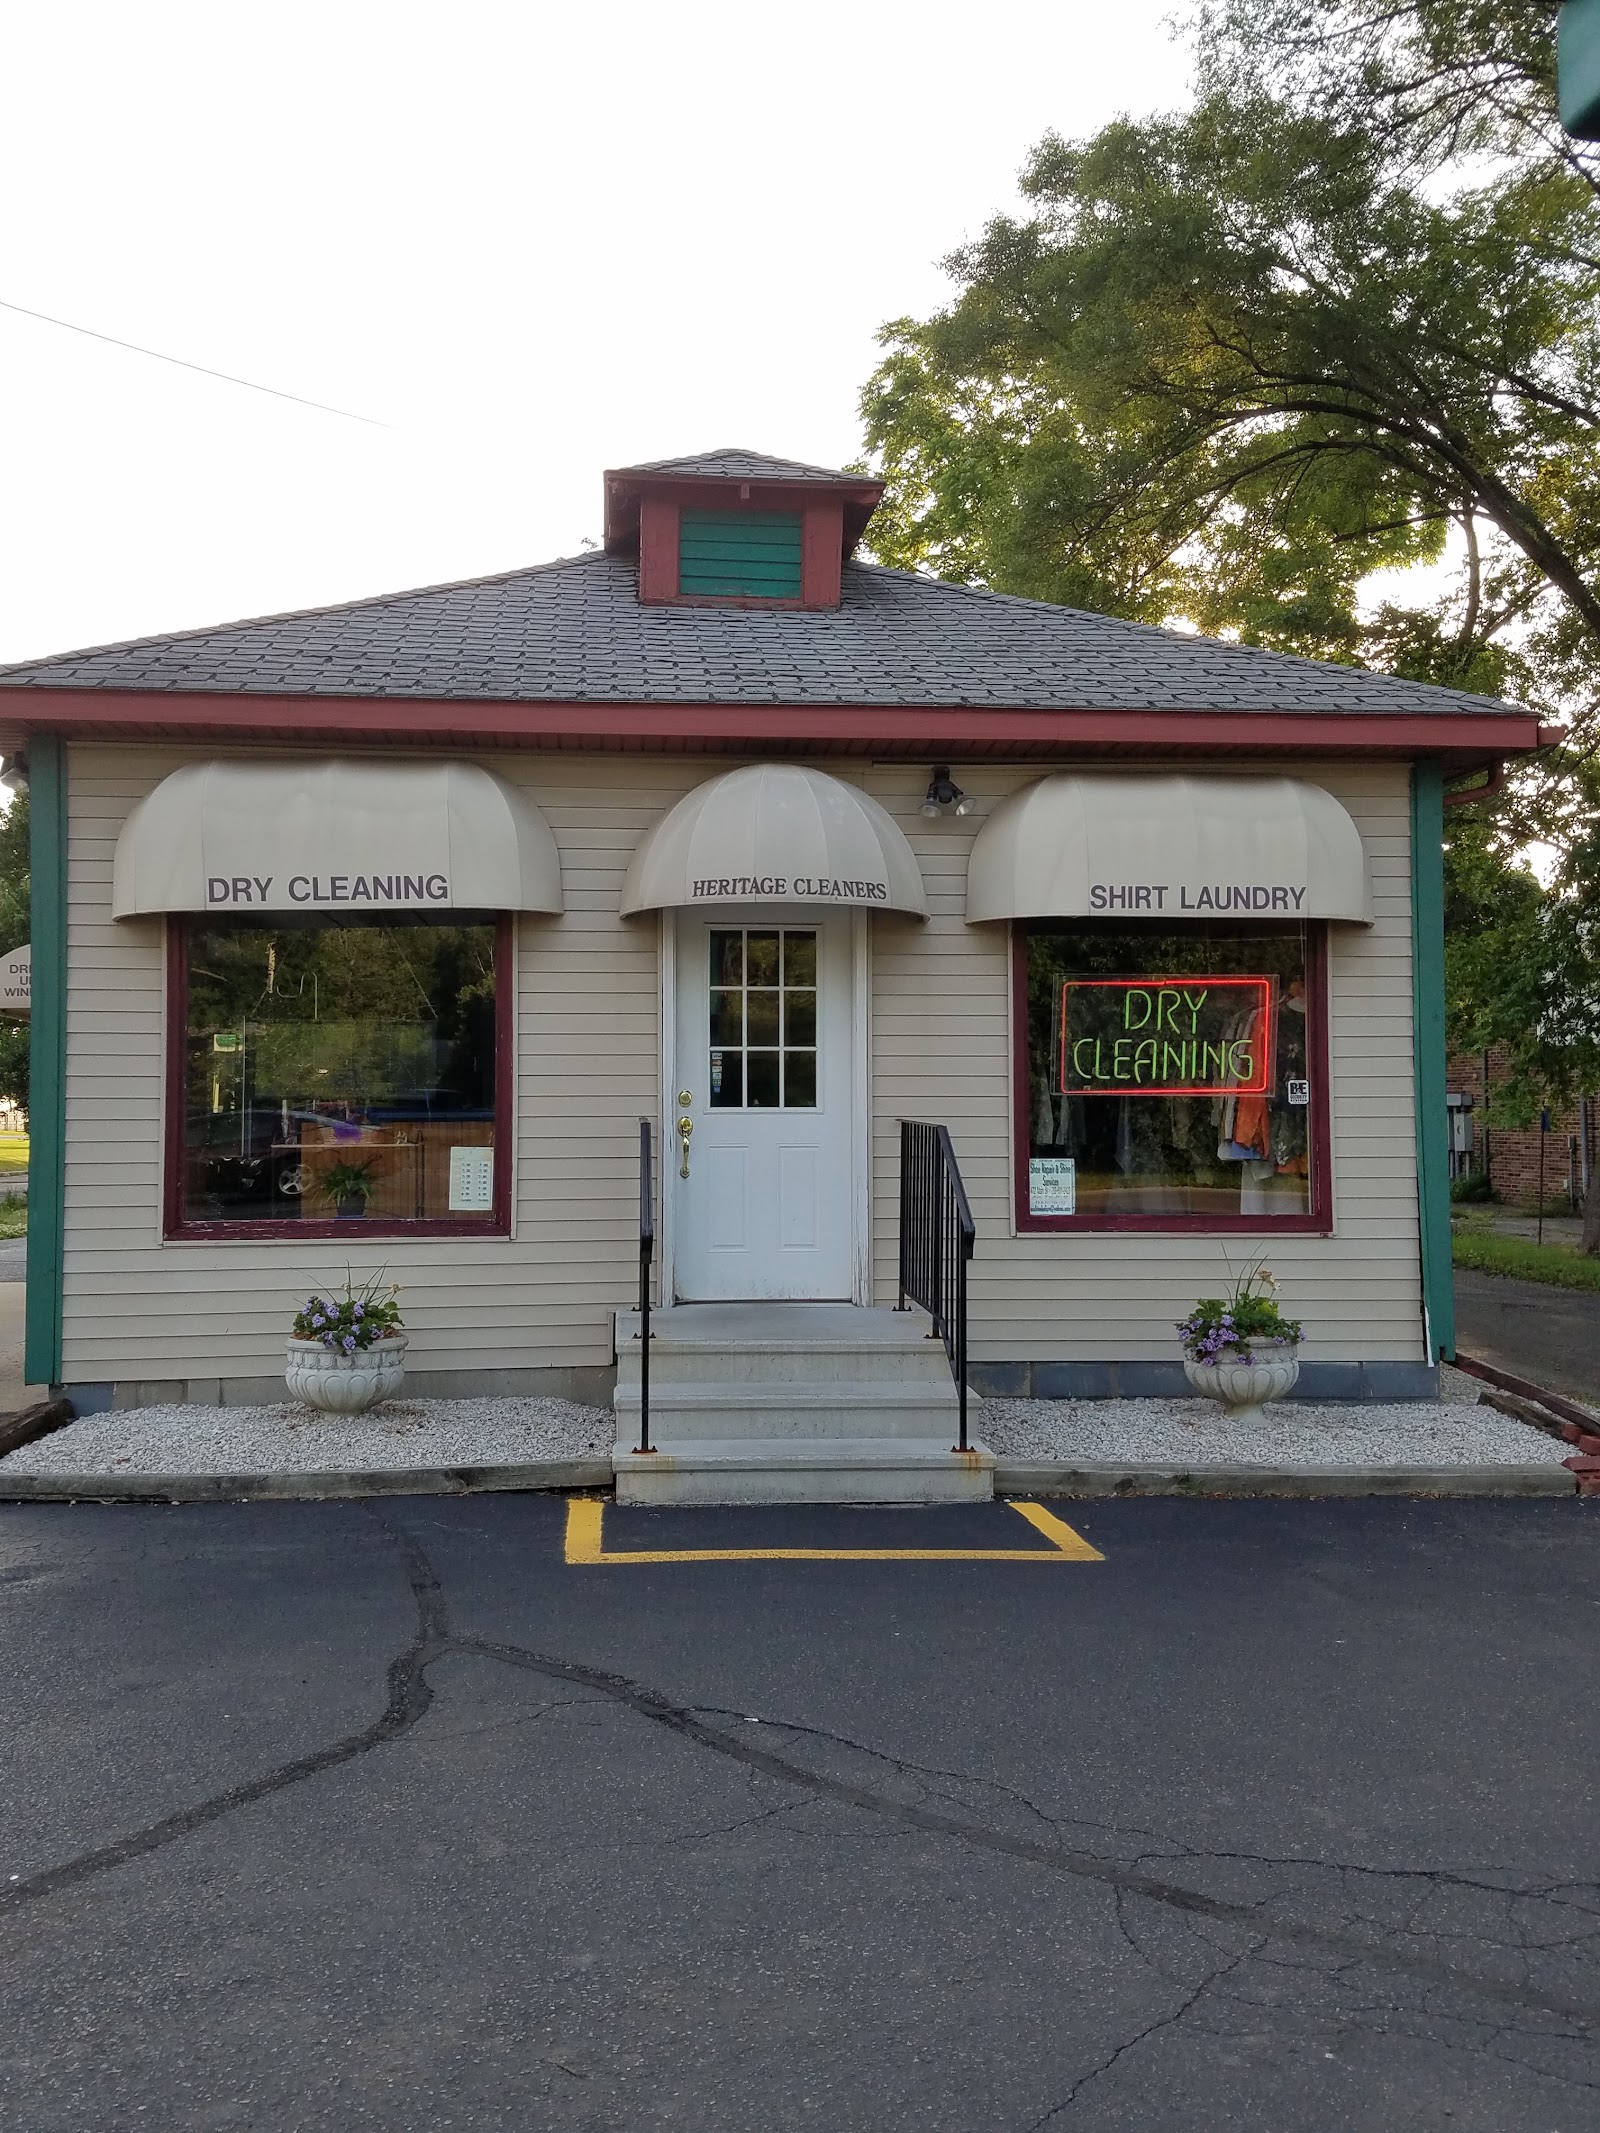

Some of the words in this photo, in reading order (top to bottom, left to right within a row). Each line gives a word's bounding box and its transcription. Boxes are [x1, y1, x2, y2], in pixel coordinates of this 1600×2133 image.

[207, 877, 273, 902] DRY
[288, 875, 448, 901] CLEANING
[692, 877, 787, 897] HERITAGE
[793, 878, 887, 899] CLEANERS
[1090, 884, 1168, 909] SHIRT
[1180, 886, 1306, 910] LAUNDRY
[4, 987, 31, 997] WIN
[20, 975, 31, 986] U
[1124, 989, 1208, 1034] DRY
[1073, 1038, 1254, 1083] CLEANING
